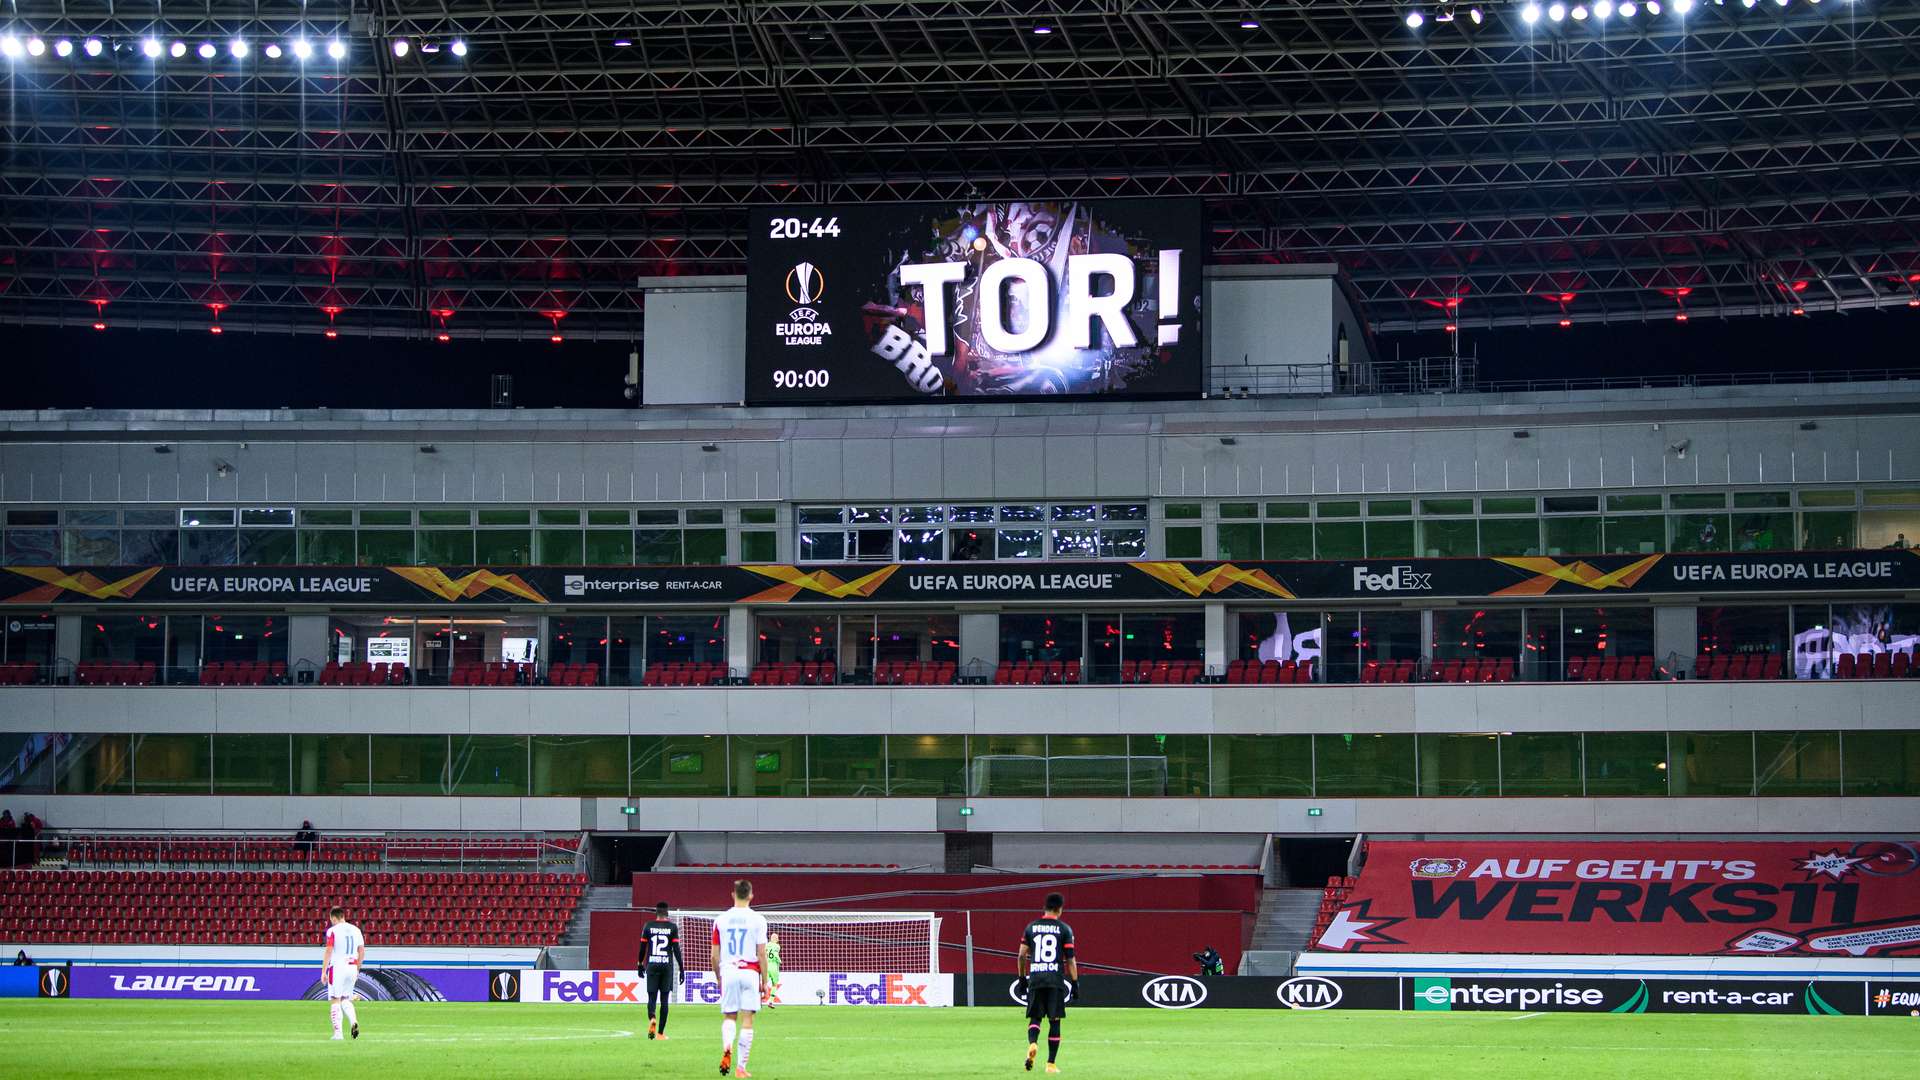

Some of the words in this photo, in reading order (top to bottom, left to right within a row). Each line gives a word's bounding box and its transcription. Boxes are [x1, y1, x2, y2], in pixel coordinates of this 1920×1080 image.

[770, 217, 841, 239] 20:44
[900, 248, 1182, 357] TOR!
[790, 309, 818, 322] UEFA
[776, 323, 832, 336] EUROPA
[785, 336, 822, 346] LEAGUE
[773, 370, 829, 388] 90:00
[1353, 565, 1432, 591] FedEx
[1673, 564, 1725, 581] UEFA
[1731, 562, 1808, 580] EUROPA
[171, 577, 219, 592] UEFA
[224, 577, 295, 592] EUROPA
[565, 577, 660, 593] enterprise
[666, 581, 722, 590] RENT-A-CAR
[909, 574, 957, 590] UEFA
[963, 574, 1035, 590] EUROPA
[1469, 858, 1571, 879] AUF
[1812, 859, 1846, 867] BAYER
[1411, 881, 1860, 924] WERKS11
[1032, 924, 1061, 934] WENDELL
[345, 935, 354, 955] 11
[651, 935, 668, 956] 12
[727, 928, 748, 956] 37
[1033, 934, 1057, 963] 18
[543, 971, 639, 1003] FedEx
[829, 974, 927, 1005] FedEx
[1153, 983, 1197, 1002] KIA
[1288, 984, 1333, 1004] KIA
[1414, 983, 1604, 1010] enterprise
[1663, 988, 1794, 1005] rent-a-car
